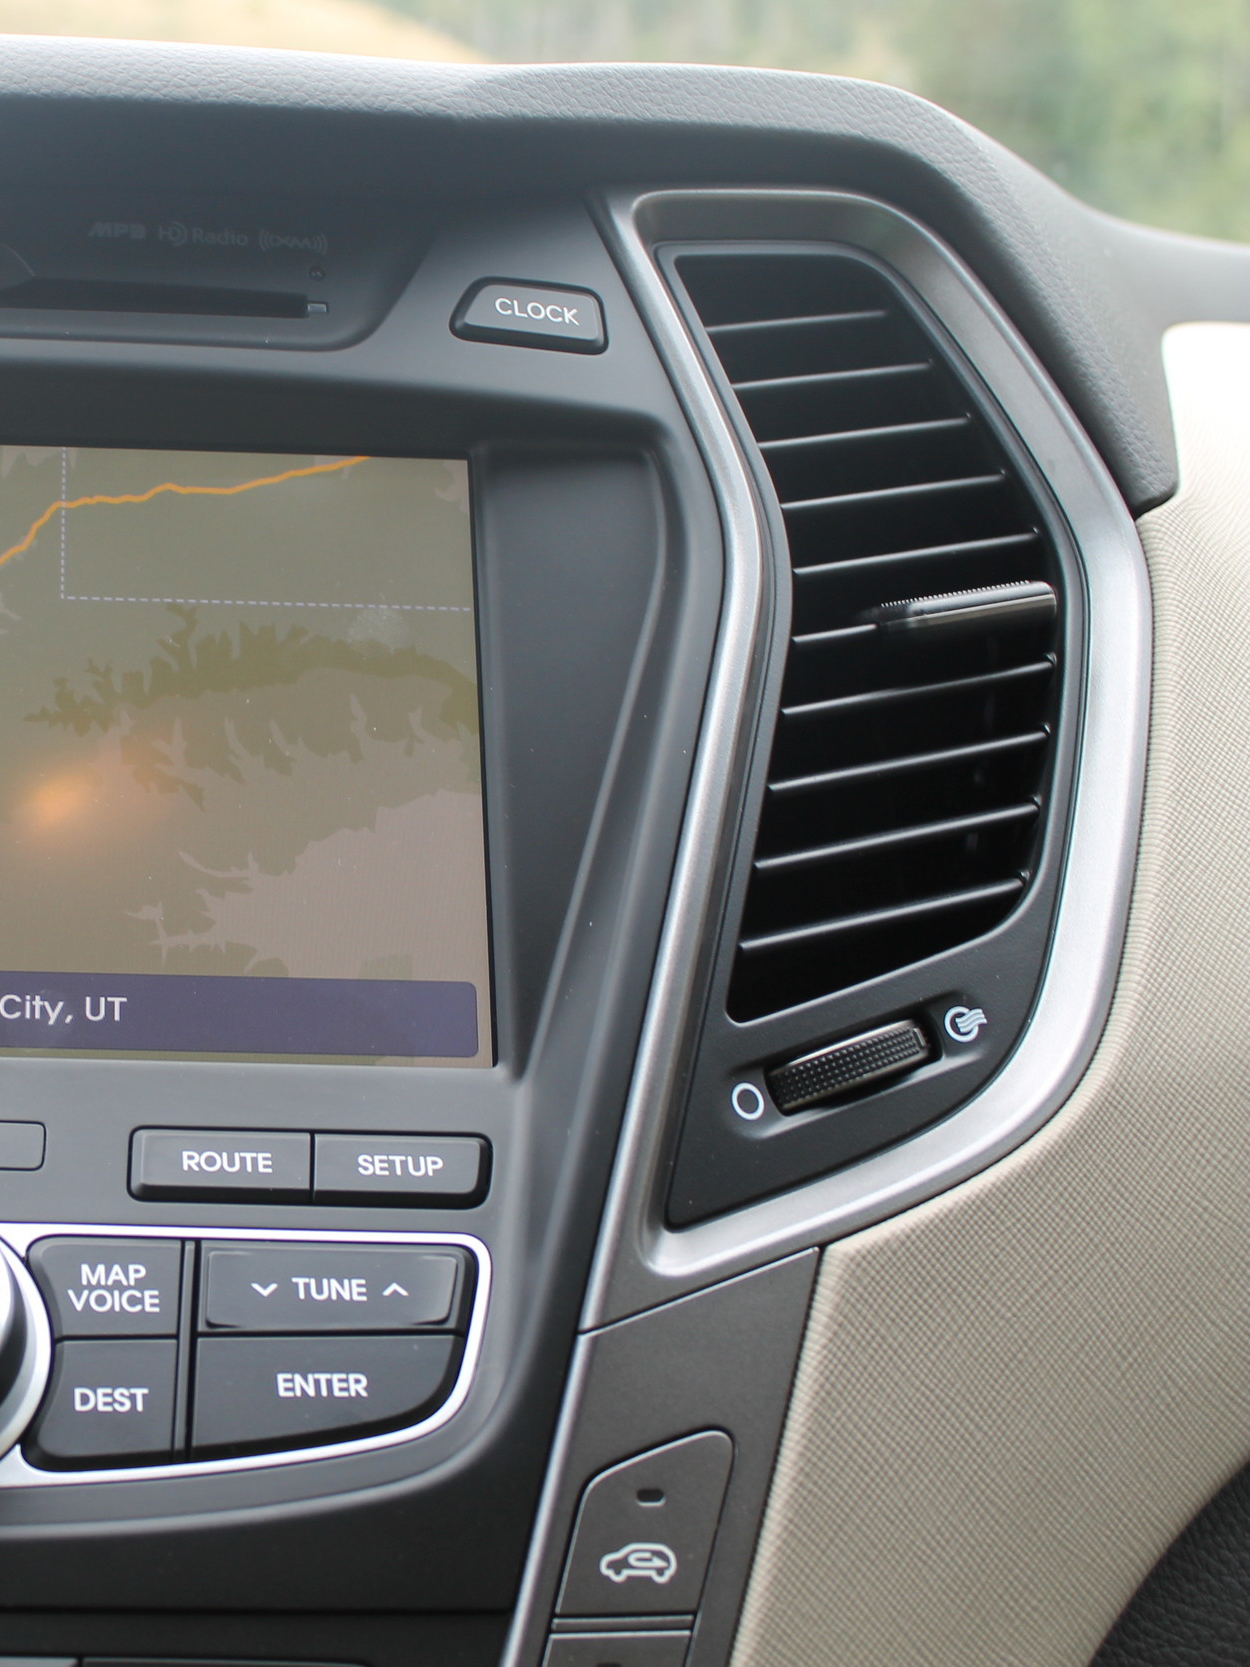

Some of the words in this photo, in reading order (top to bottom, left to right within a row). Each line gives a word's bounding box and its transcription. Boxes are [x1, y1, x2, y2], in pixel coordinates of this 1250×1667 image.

[191, 227, 249, 247] Radio
[495, 297, 579, 326] CLOCK
[85, 997, 128, 1022] UT
[181, 1150, 273, 1174] ROUTE
[357, 1154, 443, 1178] SETUP
[80, 1263, 146, 1286] MAP
[68, 1289, 161, 1313] VOICE
[292, 1277, 369, 1302] TUNE
[276, 1372, 368, 1399] ENTER
[73, 1387, 149, 1413] DEST
